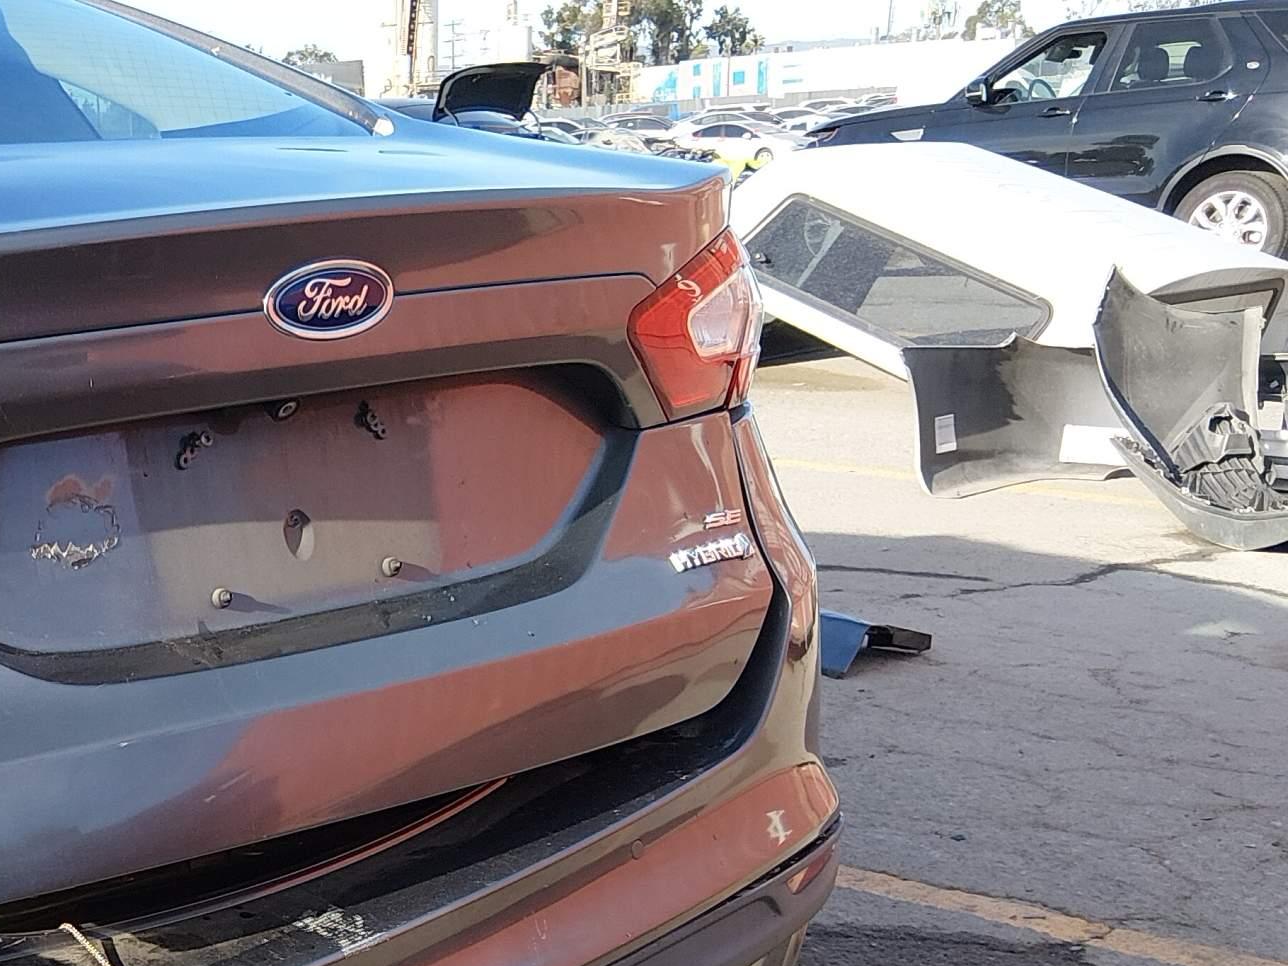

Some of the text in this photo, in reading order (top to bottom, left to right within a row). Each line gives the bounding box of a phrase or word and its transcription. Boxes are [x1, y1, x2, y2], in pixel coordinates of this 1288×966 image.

[297, 276, 369, 321] Ford
[704, 509, 742, 530] SE
[669, 534, 752, 573] HYBRID
